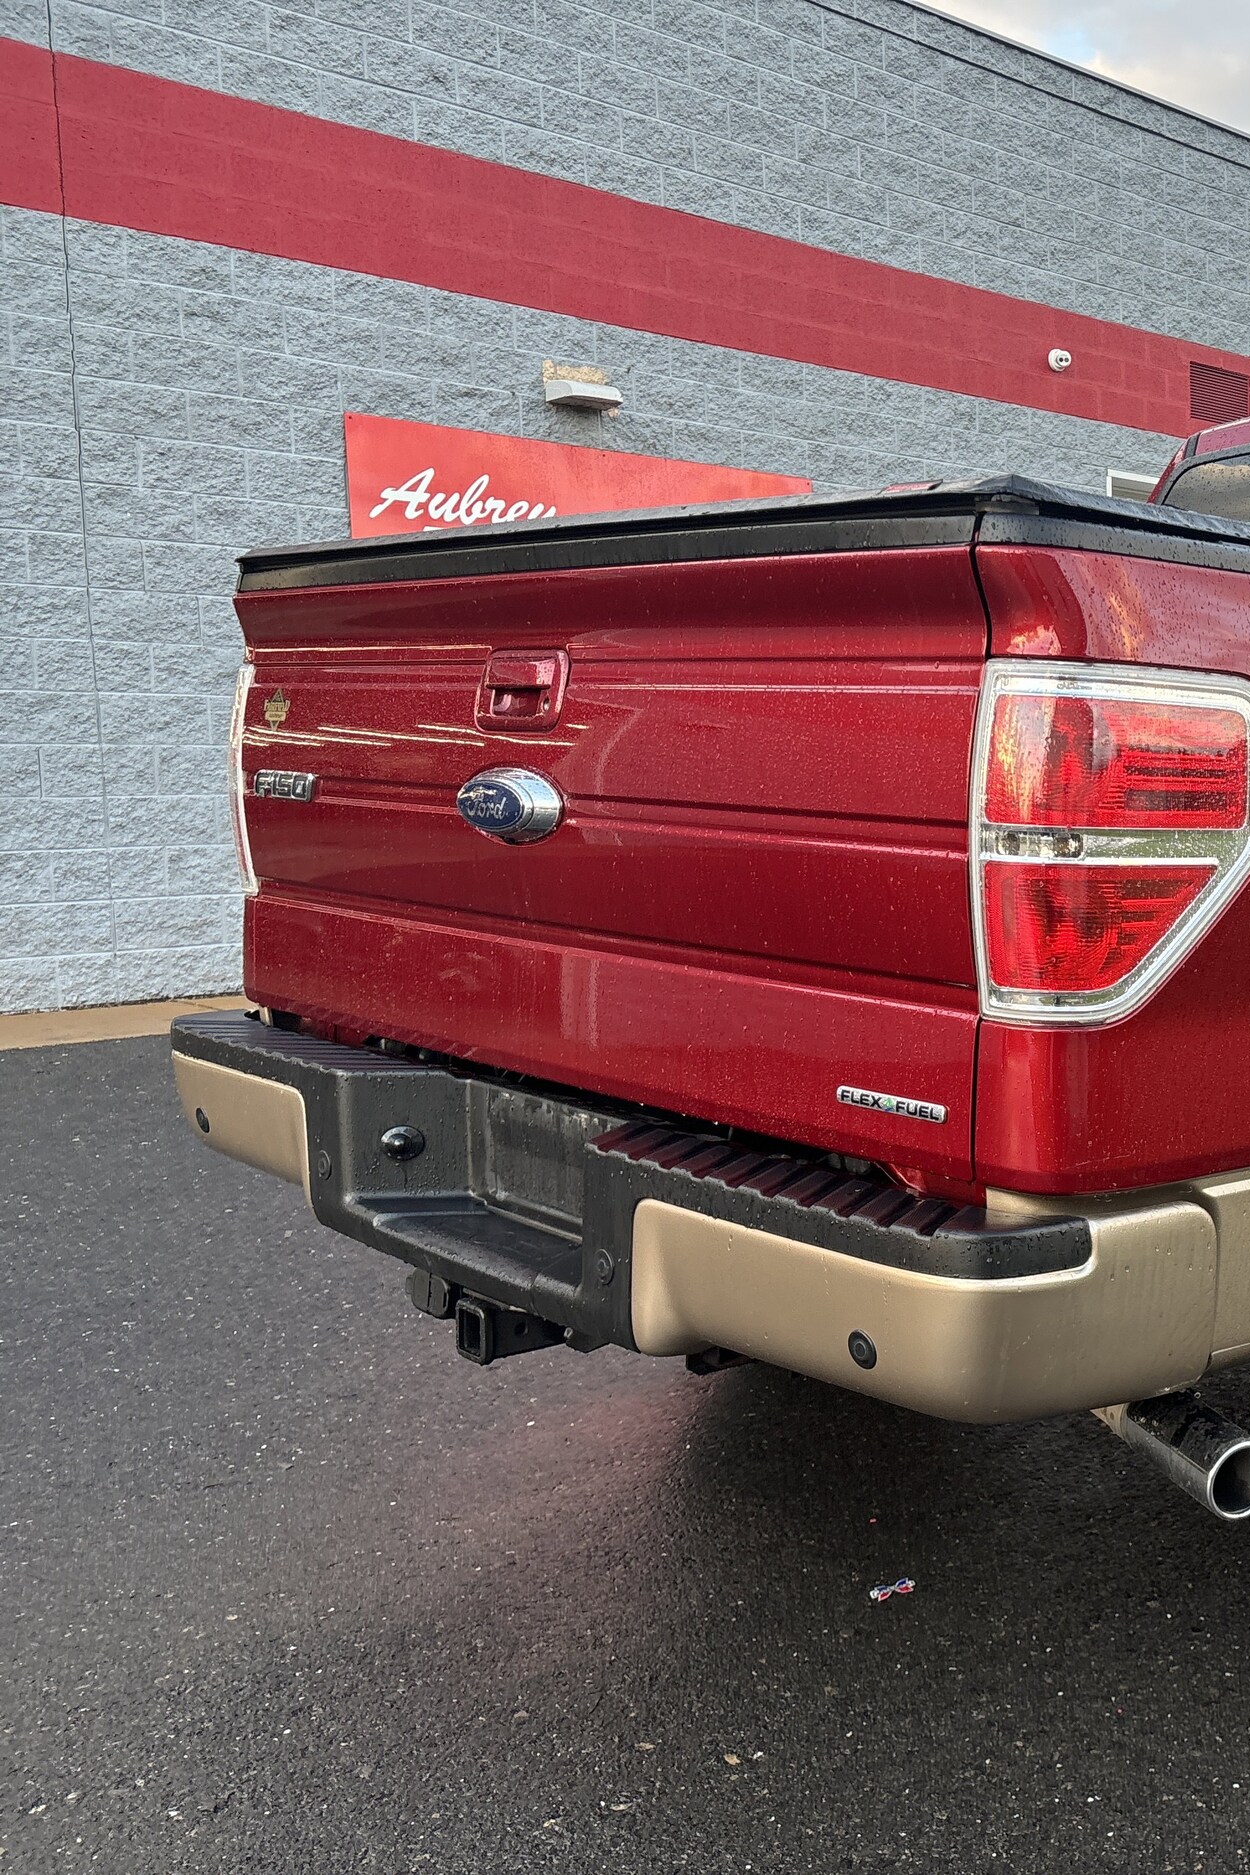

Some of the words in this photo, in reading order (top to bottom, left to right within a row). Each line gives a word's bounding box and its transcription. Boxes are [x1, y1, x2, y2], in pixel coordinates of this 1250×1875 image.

[466, 787, 508, 820] Ford
[841, 1089, 883, 1110] FLEX
[895, 1100, 940, 1121] FUEL
